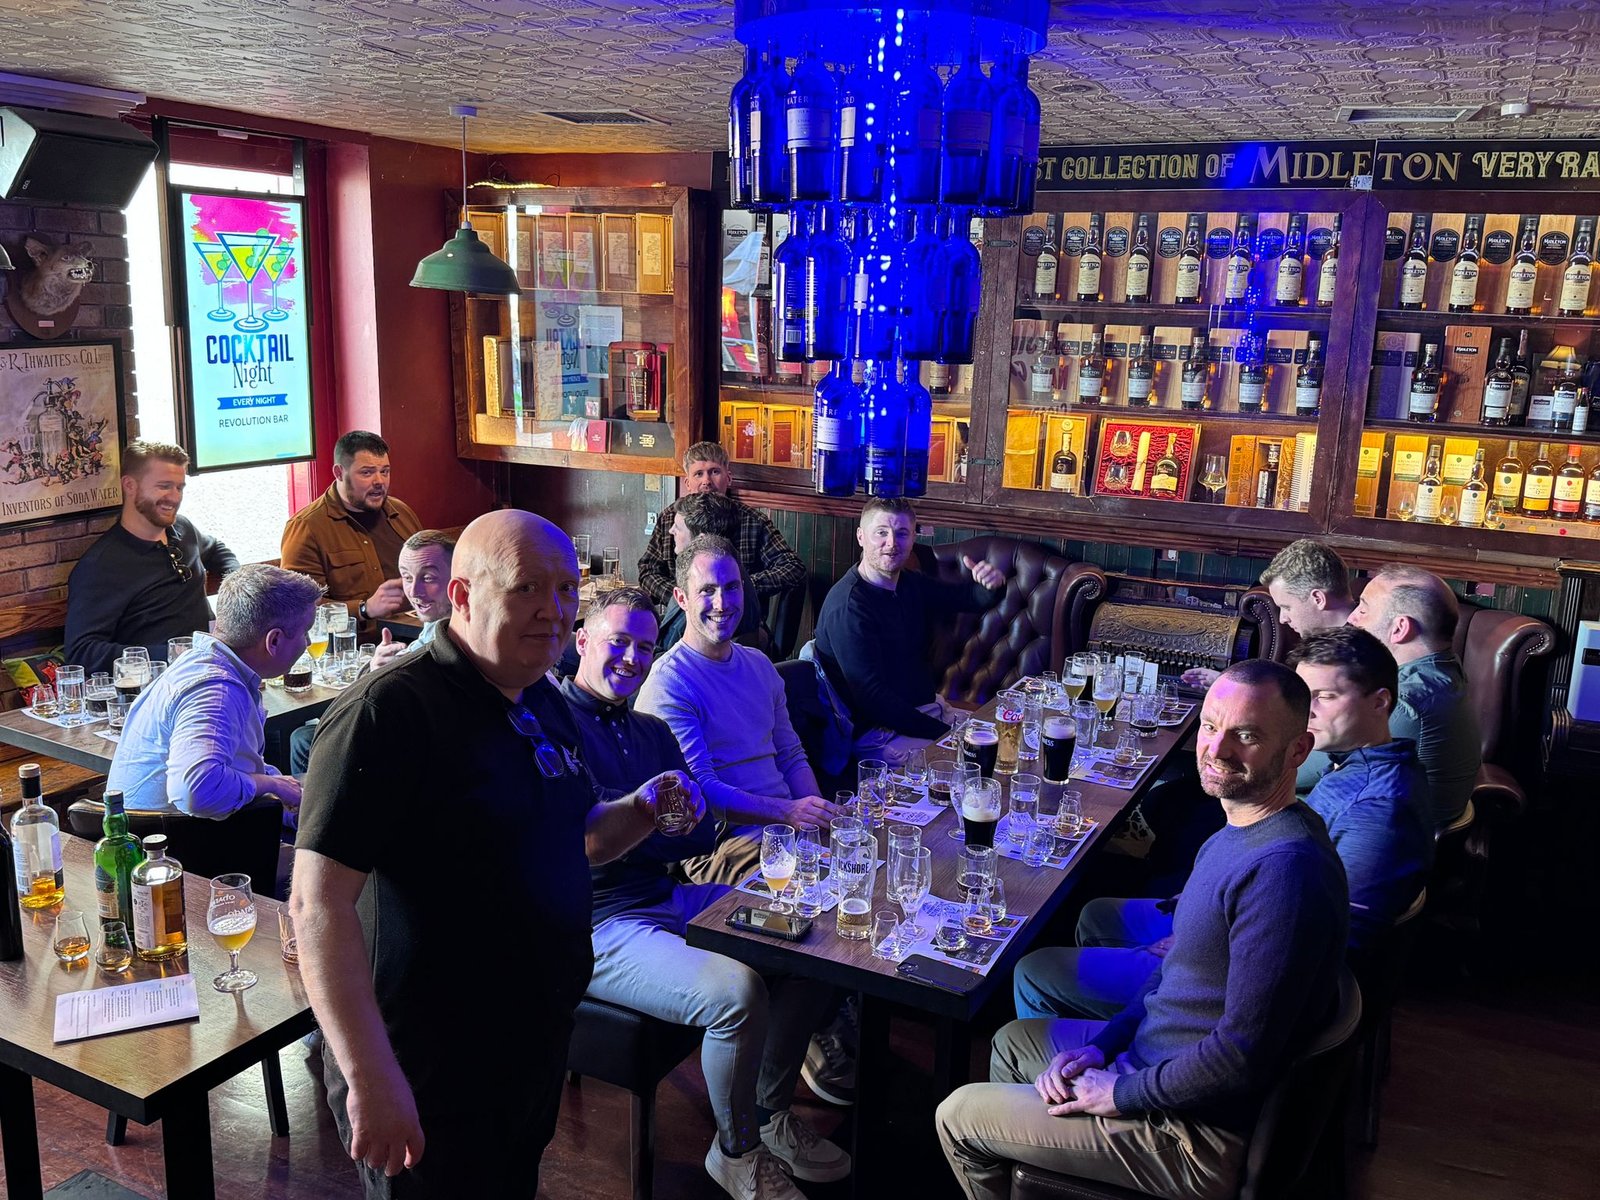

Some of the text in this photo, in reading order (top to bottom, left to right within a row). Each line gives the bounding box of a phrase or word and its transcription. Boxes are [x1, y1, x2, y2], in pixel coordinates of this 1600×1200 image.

[1061, 154, 1200, 181] COLLECTION
[1205, 153, 1236, 179] OF
[1249, 145, 1462, 184] MIDLETON
[1472, 150, 1554, 179] VERY
[206, 333, 294, 364] COCKTAIL
[233, 359, 274, 389] Night
[232, 396, 276, 407] EVERY NIGHT
[219, 414, 289, 428] REVOLUTION BAR
[2, 497, 51, 516] INVENTORS
[54, 495, 65, 507] OF
[67, 491, 89, 505] SODA
[90, 487, 118, 501] WATER
